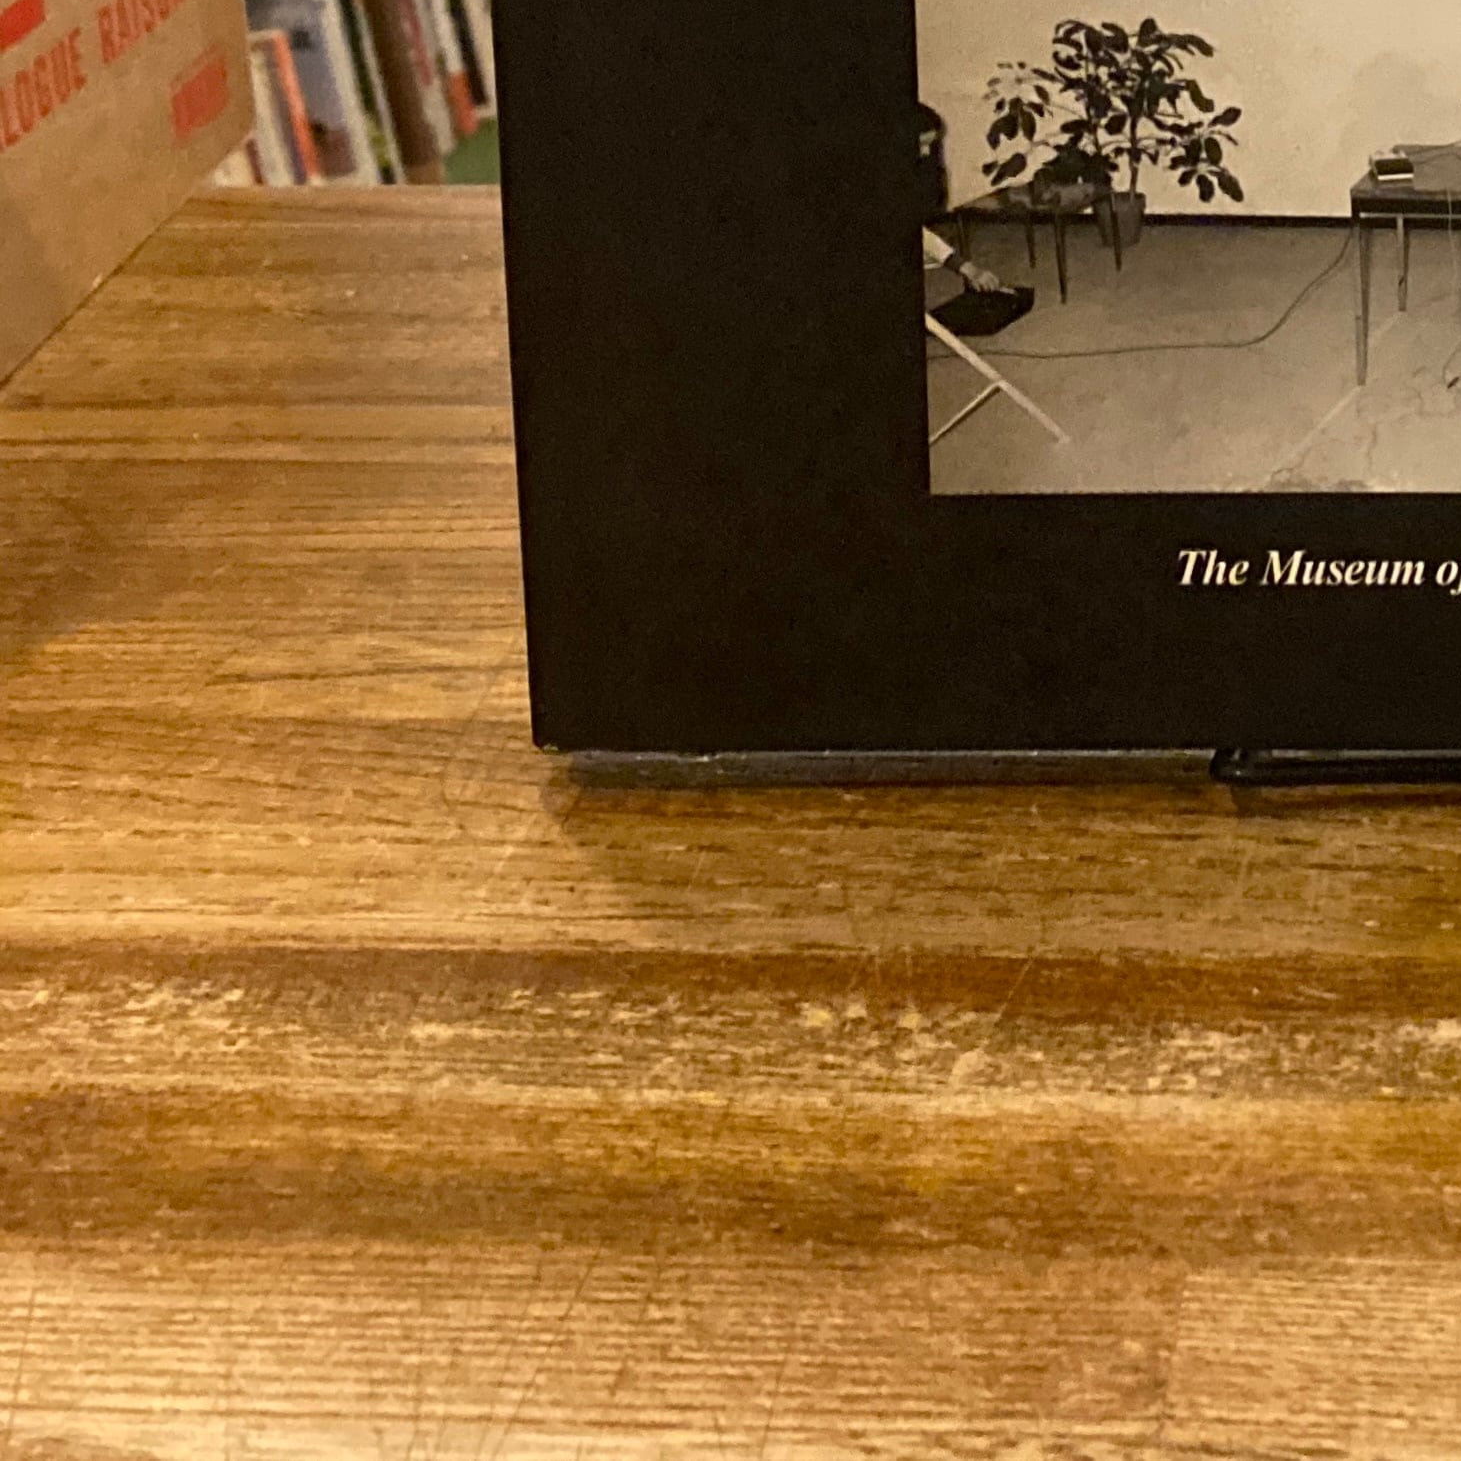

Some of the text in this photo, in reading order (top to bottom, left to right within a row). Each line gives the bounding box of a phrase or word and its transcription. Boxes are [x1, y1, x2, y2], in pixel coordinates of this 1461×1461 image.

[0, 27, 87, 152] LOGUE
[1178, 549, 1250, 586] The
[1261, 550, 1425, 586] Museum
